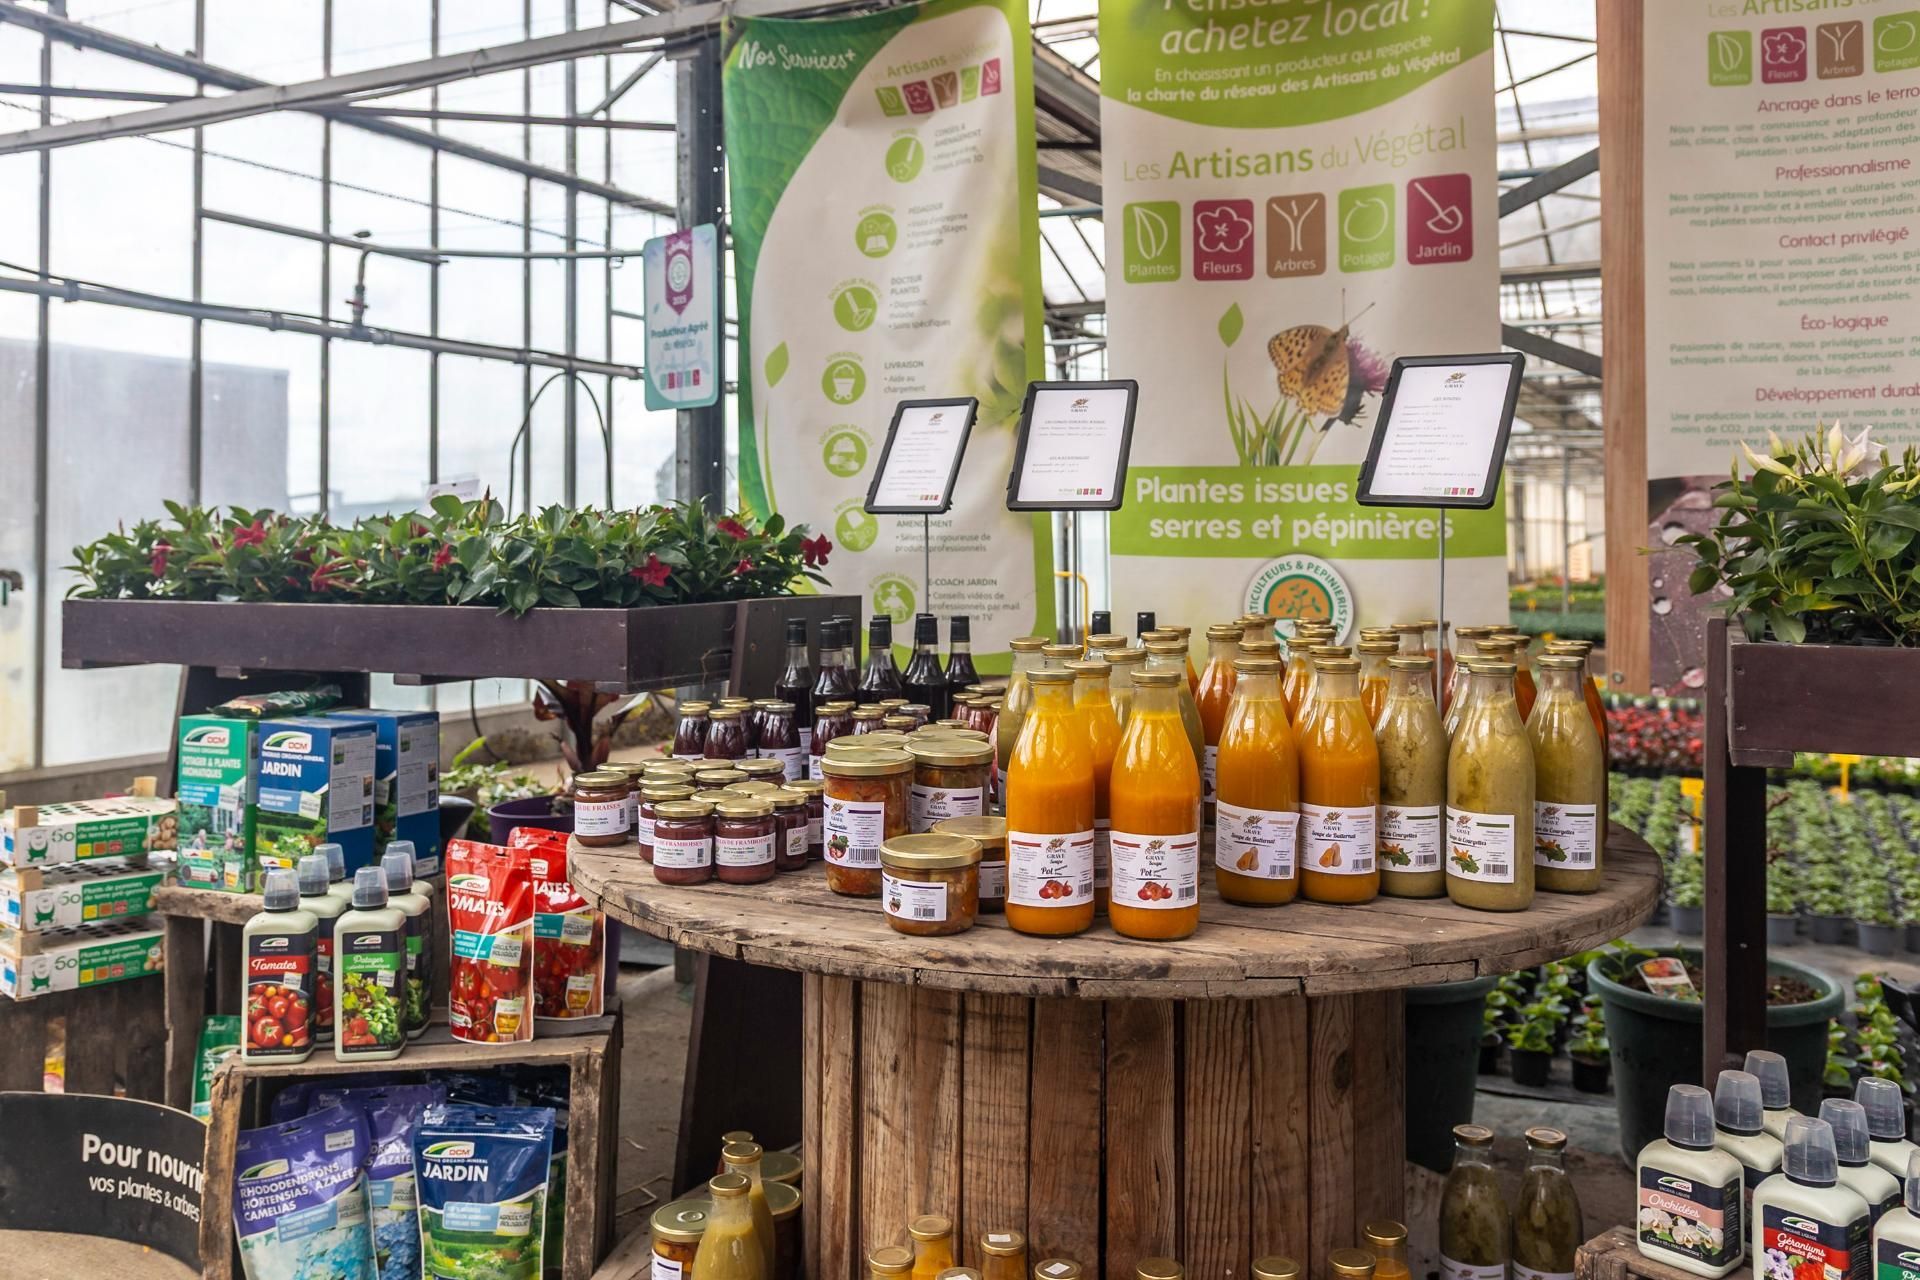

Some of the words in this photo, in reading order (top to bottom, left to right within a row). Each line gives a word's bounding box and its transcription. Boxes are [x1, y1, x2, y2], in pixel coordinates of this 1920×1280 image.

[1707, 3, 1738, 18] Les
[1742, 0, 1851, 16] Artisans
[1160, 14, 1311, 55] achetez
[1322, 0, 1409, 37] local
[1419, 0, 1431, 18] !
[738, 40, 776, 69] Nos
[778, 44, 856, 71] Services+
[1155, 67, 1171, 82] En
[1175, 64, 1250, 82] choisissant
[1254, 64, 1271, 77] un
[1275, 52, 1348, 76] producteur
[1352, 49, 1373, 66] qui
[1376, 34, 1432, 59] respecte
[887, 55, 947, 78] Artisans
[1127, 88, 1140, 102] la
[1145, 86, 1195, 102] charte
[1199, 84, 1219, 101] du
[1223, 81, 1276, 99] réseau
[1281, 77, 1308, 93] des
[1312, 67, 1376, 89] Artisans
[1381, 64, 1400, 79] du
[1403, 47, 1460, 75] Végétal
[1767, 70, 1799, 80] Fleurs
[1822, 65, 1857, 76] Arbres
[1877, 56, 1919, 69] Potager
[1757, 98, 1820, 113] Ancrage
[1824, 94, 1863, 108] dans
[1867, 90, 1881, 103] le
[1761, 118, 1829, 131] connaissance
[1837, 116, 1850, 125] en
[1857, 108, 1917, 125] profondeur
[1833, 125, 1892, 139] adaptation
[1896, 122, 1915, 132] des
[1123, 160, 1161, 182] Les
[1167, 147, 1313, 180] Artisans
[1320, 144, 1348, 170] du
[1354, 115, 1467, 169] Végétal
[1775, 158, 1911, 182] Professionnalisme
[1764, 188, 1821, 199] botaniques
[1826, 186, 1837, 195] et
[1842, 181, 1896, 193] culturales
[1850, 196, 1878, 206] votre
[1881, 191, 1916, 205] jardin.
[1817, 212, 1842, 223] pour
[1844, 210, 1866, 220] être
[1869, 205, 1914, 217] vendues
[1779, 233, 1836, 248] Contact
[1841, 226, 1909, 249] privilégié
[1129, 262, 1175, 276] Plantes
[1202, 260, 1242, 274] Fleurs
[1274, 258, 1316, 272] Arbres
[1343, 249, 1391, 267] Potager
[1415, 242, 1462, 259] Jardin
[1872, 252, 1898, 261] vous
[1788, 269, 1835, 280] proposer
[1839, 267, 1858, 276] des
[1862, 263, 1912, 275] solutions
[1799, 280, 1855, 292] primordial
[1858, 280, 1871, 288] de
[1873, 278, 1903, 287] tisser
[1849, 294, 1860, 303] et
[1800, 313, 1889, 332] Éco-logique
[1827, 349, 1905, 361] respectueuses
[884, 360, 925, 370] LIVRAISON
[883, 384, 926, 395] chargement
[1755, 384, 1876, 403] Développement
[1136, 476, 1244, 503] Plantes
[1255, 477, 1349, 503] issues
[1149, 517, 1241, 539] serres
[1252, 513, 1282, 539] et
[1292, 511, 1455, 546] pépinières
[936, 533, 979, 543] rigoureuse
[980, 533, 992, 541] de
[928, 544, 987, 553] professionnels
[966, 578, 998, 587] JARDIN
[932, 591, 965, 600] Conseils
[968, 591, 994, 599] vidéos
[995, 591, 1006, 599] de
[1295, 560, 1304, 570] &
[1306, 561, 1348, 633] PEPINIERISTE
[988, 602, 1000, 611] par
[1002, 601, 1020, 610] mail
[982, 613, 993, 622] TV
[206, 736, 226, 744] DCM
[288, 741, 308, 750] DCM
[261, 761, 302, 778] JARDIN
[665, 840, 703, 848] FRAMBOISES
[1040, 867, 1053, 875] Pot
[1140, 868, 1152, 877] Pot
[466, 881, 485, 889] DCM
[251, 958, 297, 970] Tomates
[352, 954, 385, 967] Potager
[81, 1132, 142, 1169] Pour
[240, 1162, 344, 1199] RHODODENDRONS,
[422, 1161, 489, 1183] JARDIN
[1675, 1182, 1690, 1191] DCM
[89, 1175, 115, 1195] vos
[117, 1176, 163, 1204] plantes
[164, 1191, 173, 1208] &
[173, 1195, 201, 1223] arbres
[242, 1184, 313, 1210] HORTENSIAS,
[1648, 1193, 1701, 1218] Orchidées
[244, 1200, 297, 1222] CAMELIAS
[1800, 1223, 1817, 1232] DCM
[1776, 1232, 1826, 1257] Géraniums
[1806, 1252, 1824, 1263] fleurs
